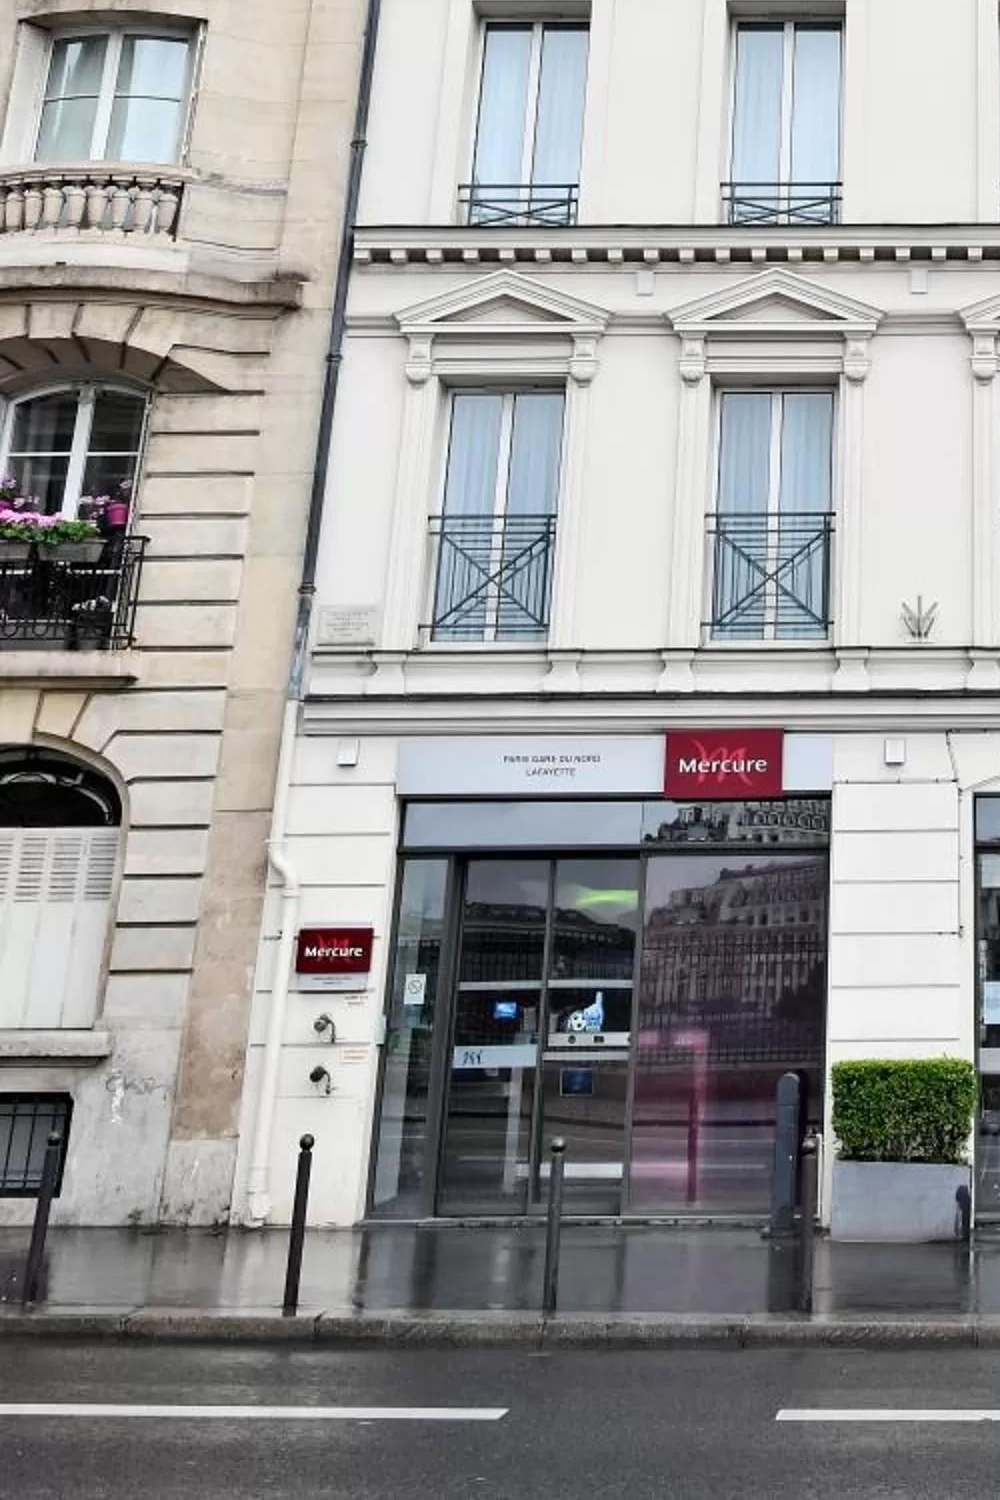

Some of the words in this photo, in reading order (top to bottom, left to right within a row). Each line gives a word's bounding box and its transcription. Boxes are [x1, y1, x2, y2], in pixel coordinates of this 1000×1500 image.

[559, 754, 573, 763] DU
[678, 757, 768, 773] Mercure
[303, 946, 364, 957] Mercure
